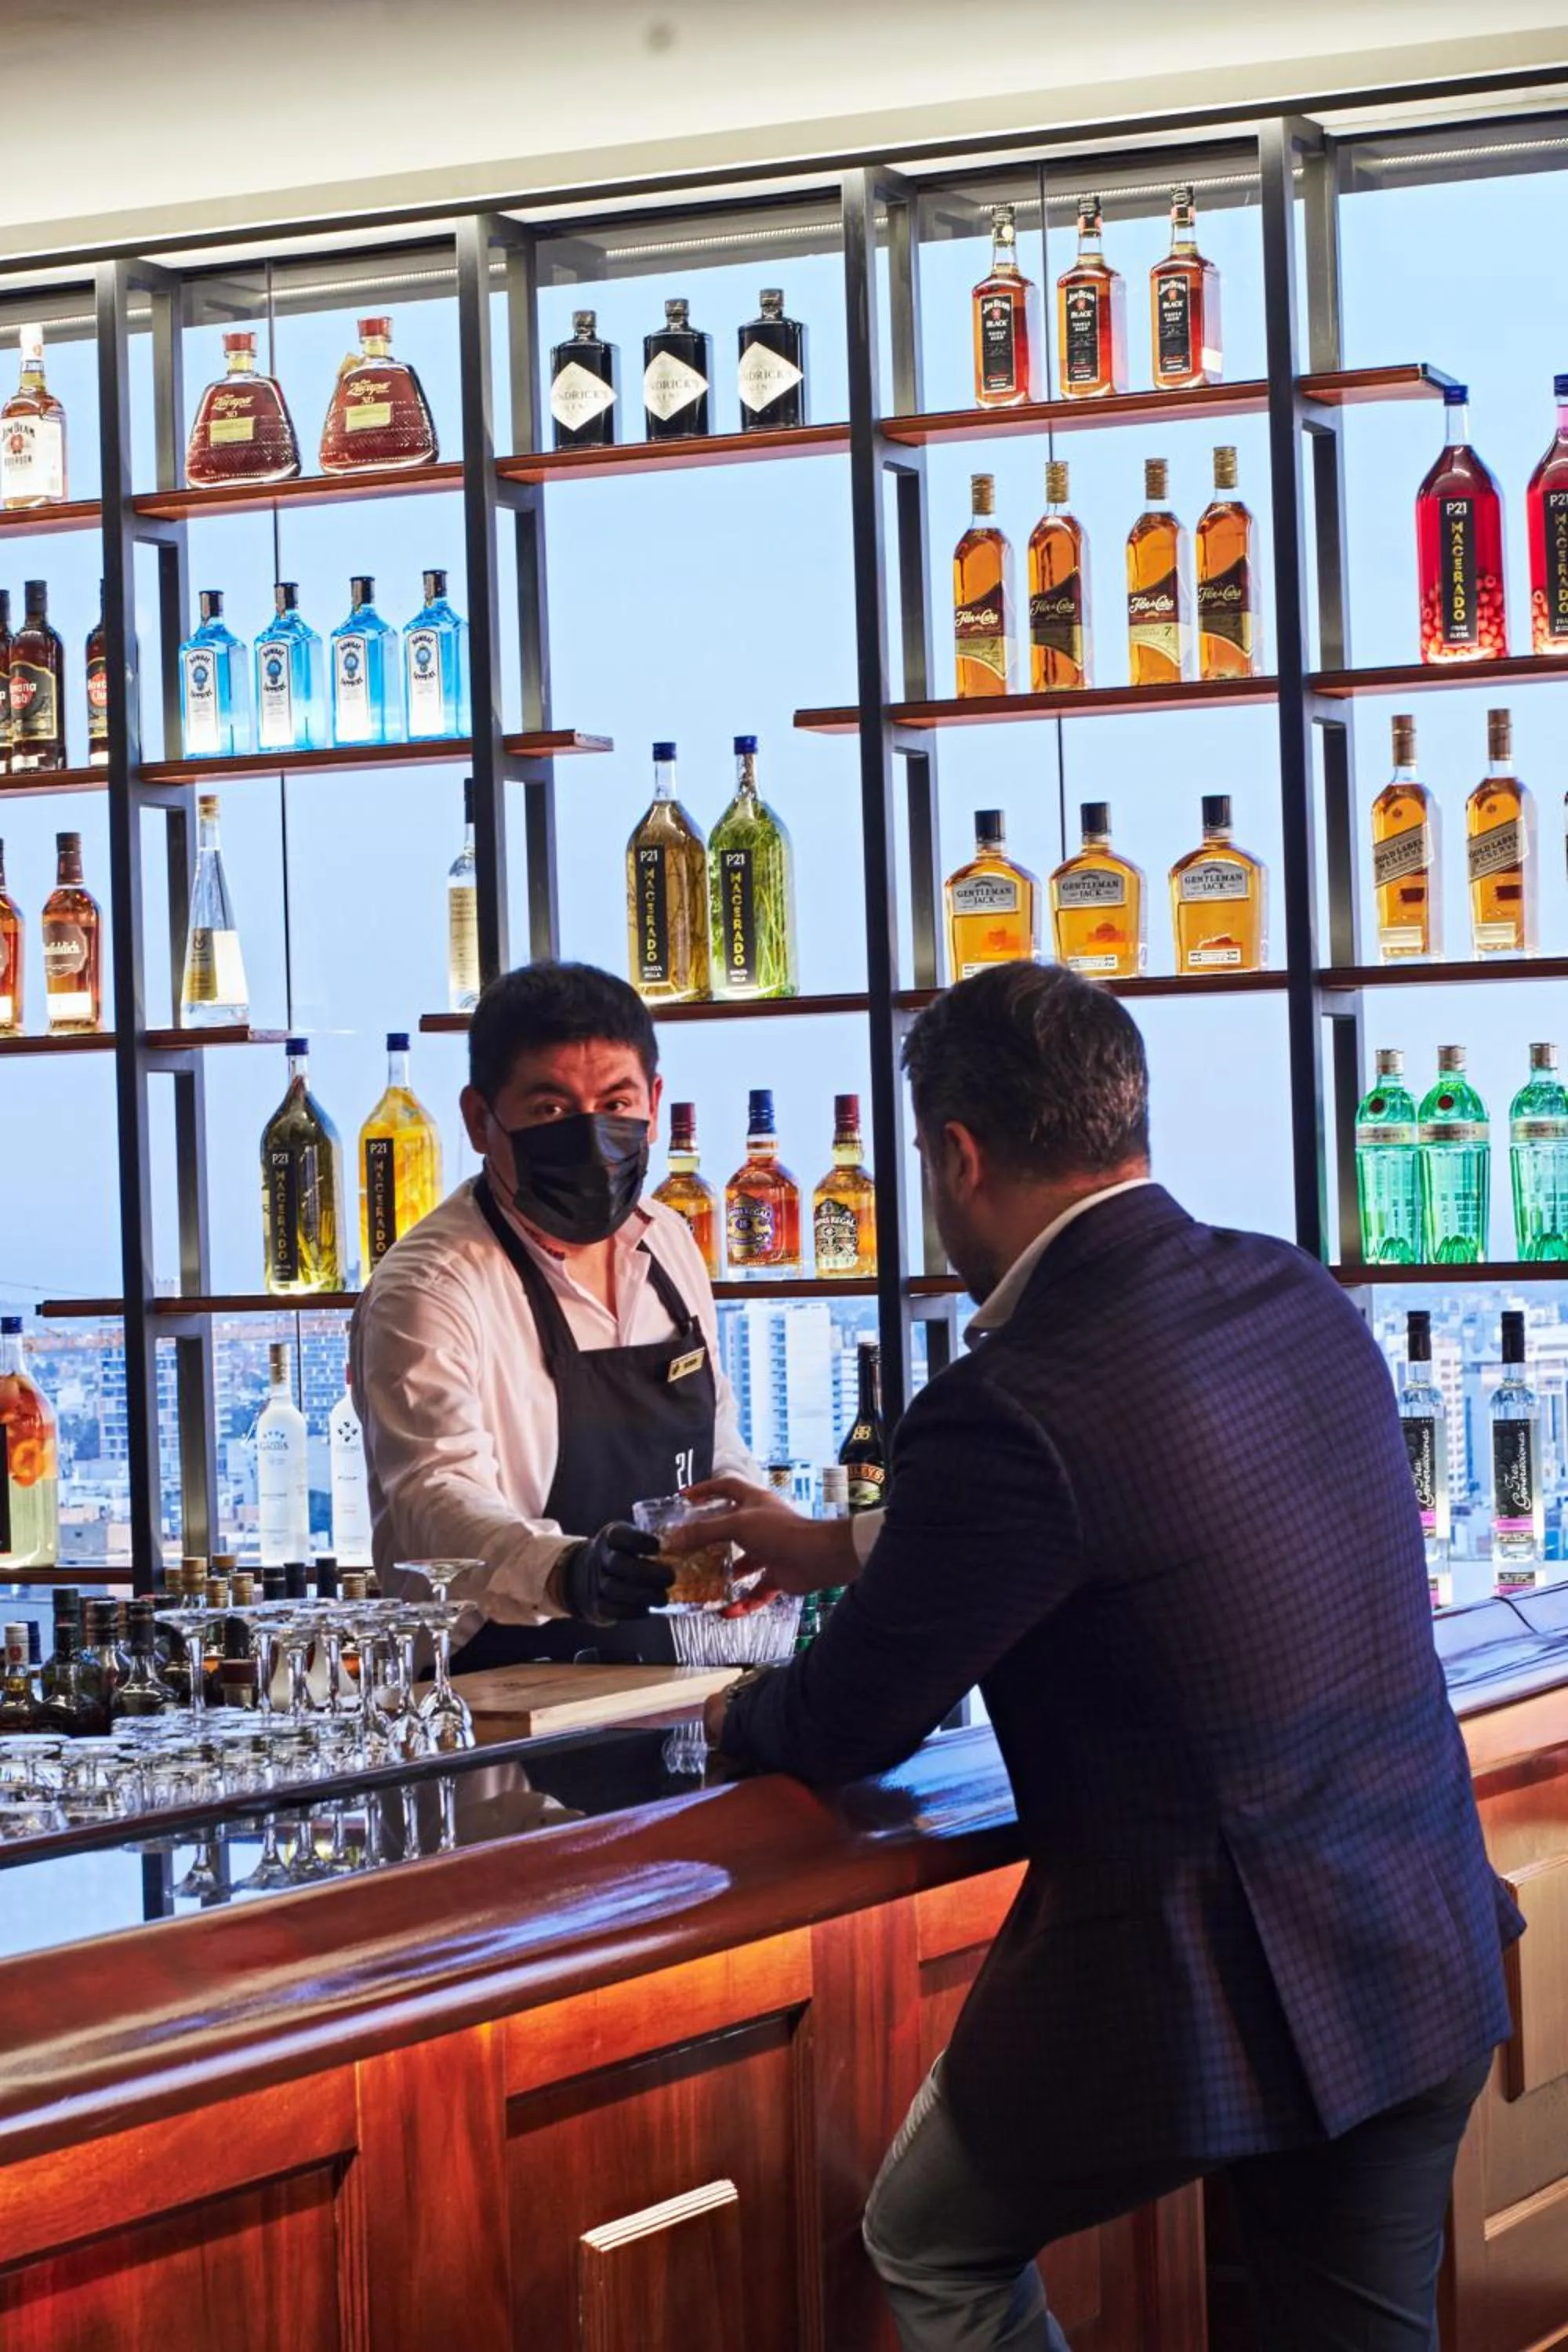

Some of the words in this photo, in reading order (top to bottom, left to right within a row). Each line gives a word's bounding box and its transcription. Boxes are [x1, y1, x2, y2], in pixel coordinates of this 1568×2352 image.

[1163, 300, 1184, 310] BLACK
[1070, 310, 1092, 319] BLACK
[985, 320, 1007, 328] BLACK
[1446, 502, 1468, 516] P21
[1450, 521, 1466, 621] MACERADO
[1164, 626, 1172, 637] 7
[989, 638, 998, 650] 7
[1396, 837, 1425, 854] LABEL
[1491, 833, 1519, 848] LABEL
[640, 849, 658, 862] P21
[726, 853, 745, 866] P21
[1062, 879, 1119, 891] GENTLEMAN
[1185, 873, 1243, 884] GENTLEMAN
[956, 887, 1012, 898] GENTLEMAN
[1203, 882, 1225, 891] JACK
[644, 868, 658, 962] MACERADO
[730, 871, 745, 967] MACERADO
[370, 1142, 387, 1155] P21
[272, 1153, 289, 1165] P21
[374, 1160, 387, 1253] MACERADO
[276, 1170, 287, 1261] MACERADO
